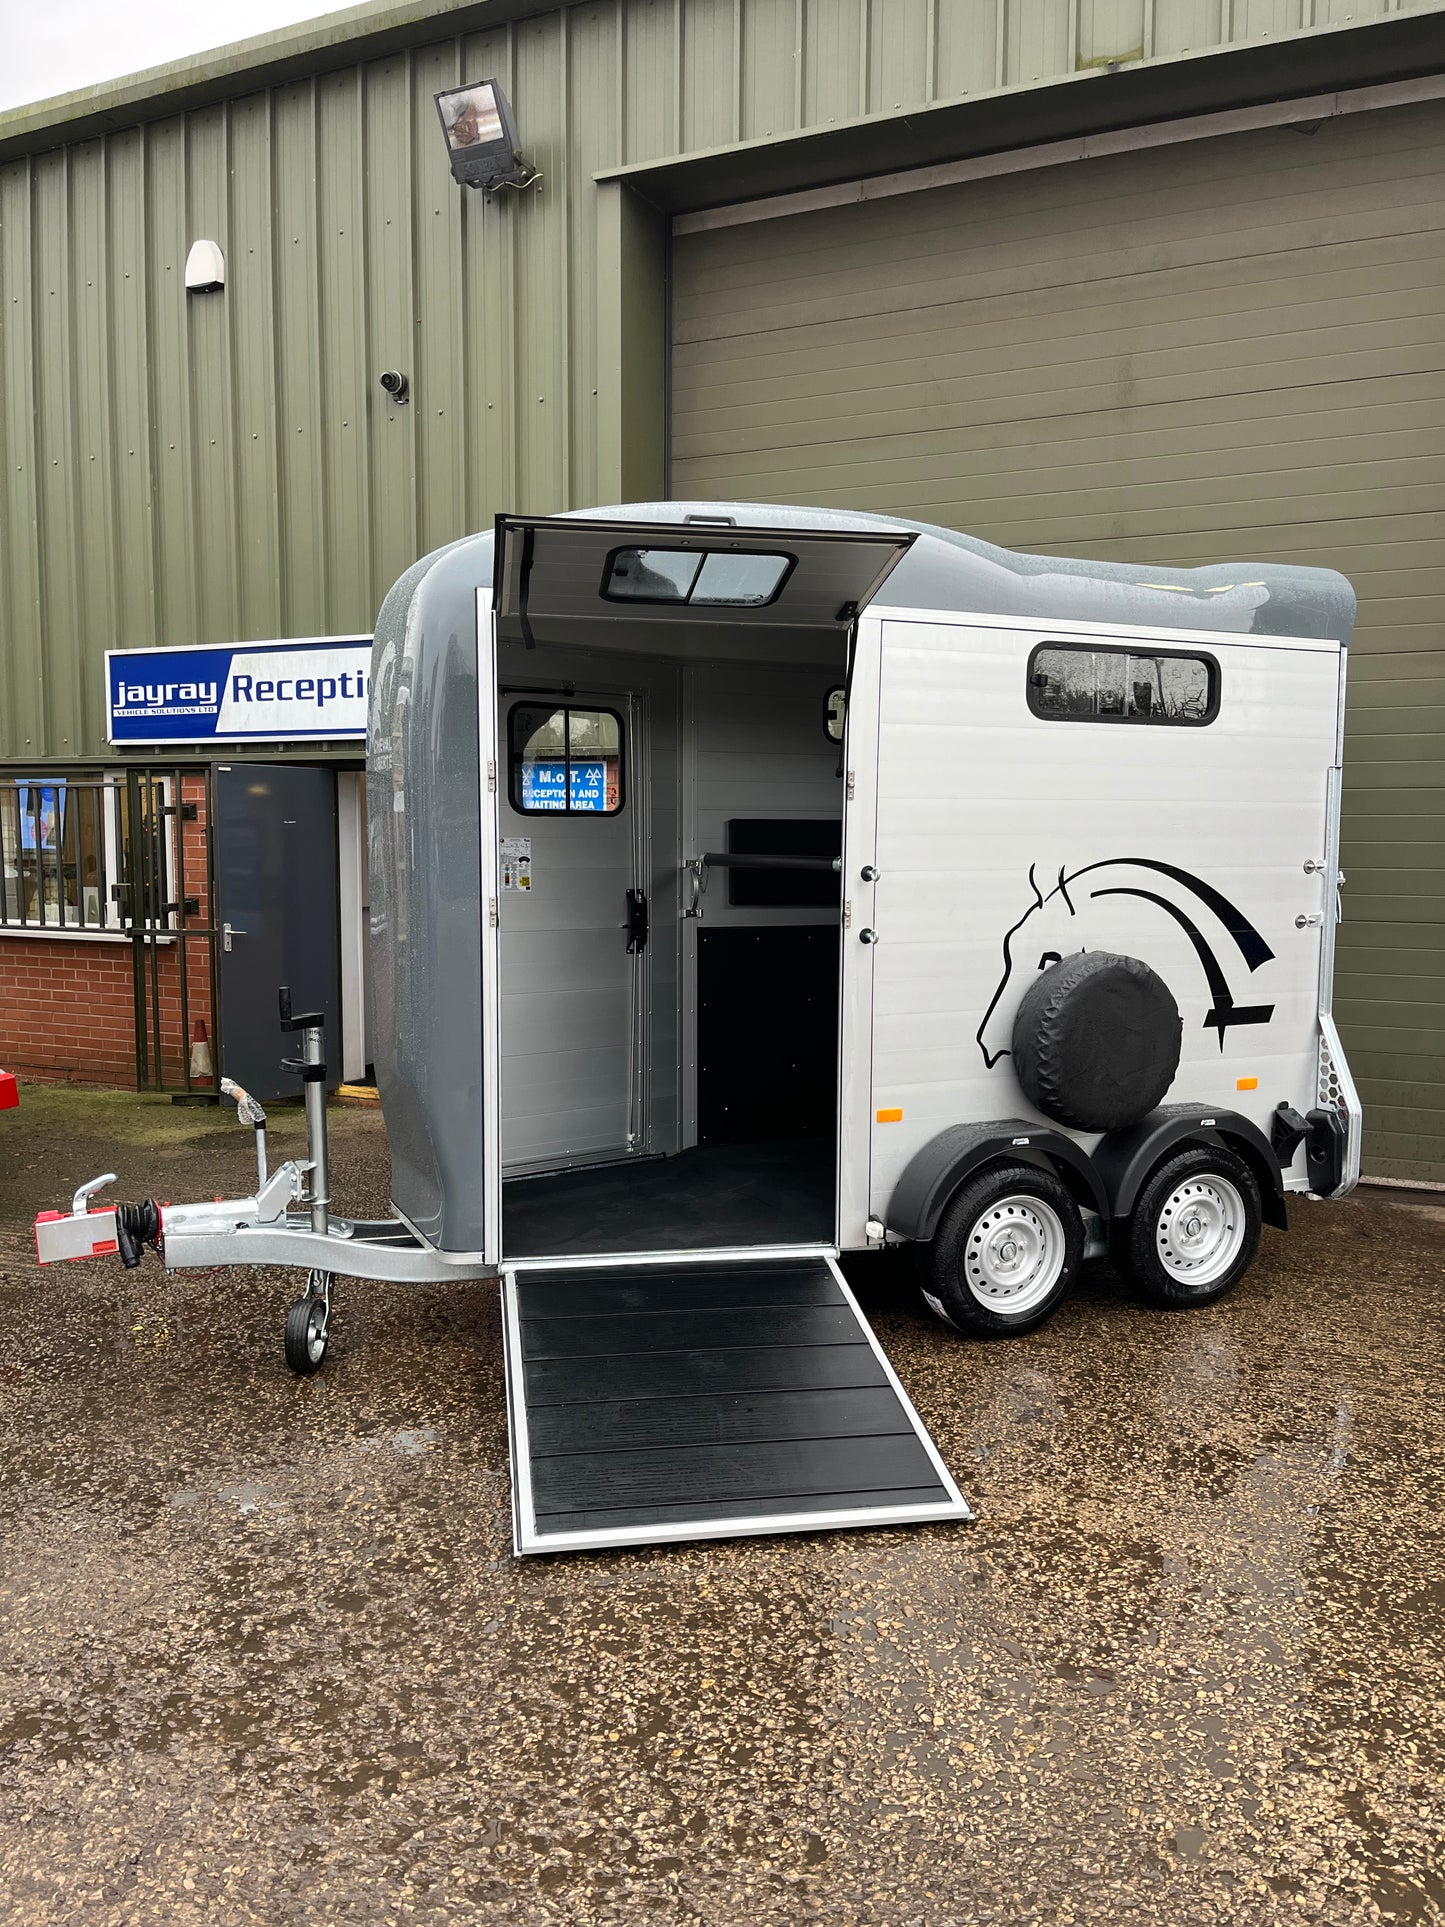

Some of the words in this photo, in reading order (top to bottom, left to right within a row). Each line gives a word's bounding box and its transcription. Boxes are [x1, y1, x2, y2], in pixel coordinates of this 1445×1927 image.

[113, 681, 217, 708] jayray
[232, 669, 371, 707] Recepti
[578, 789, 599, 798] AND
[570, 800, 594, 809] AREA
